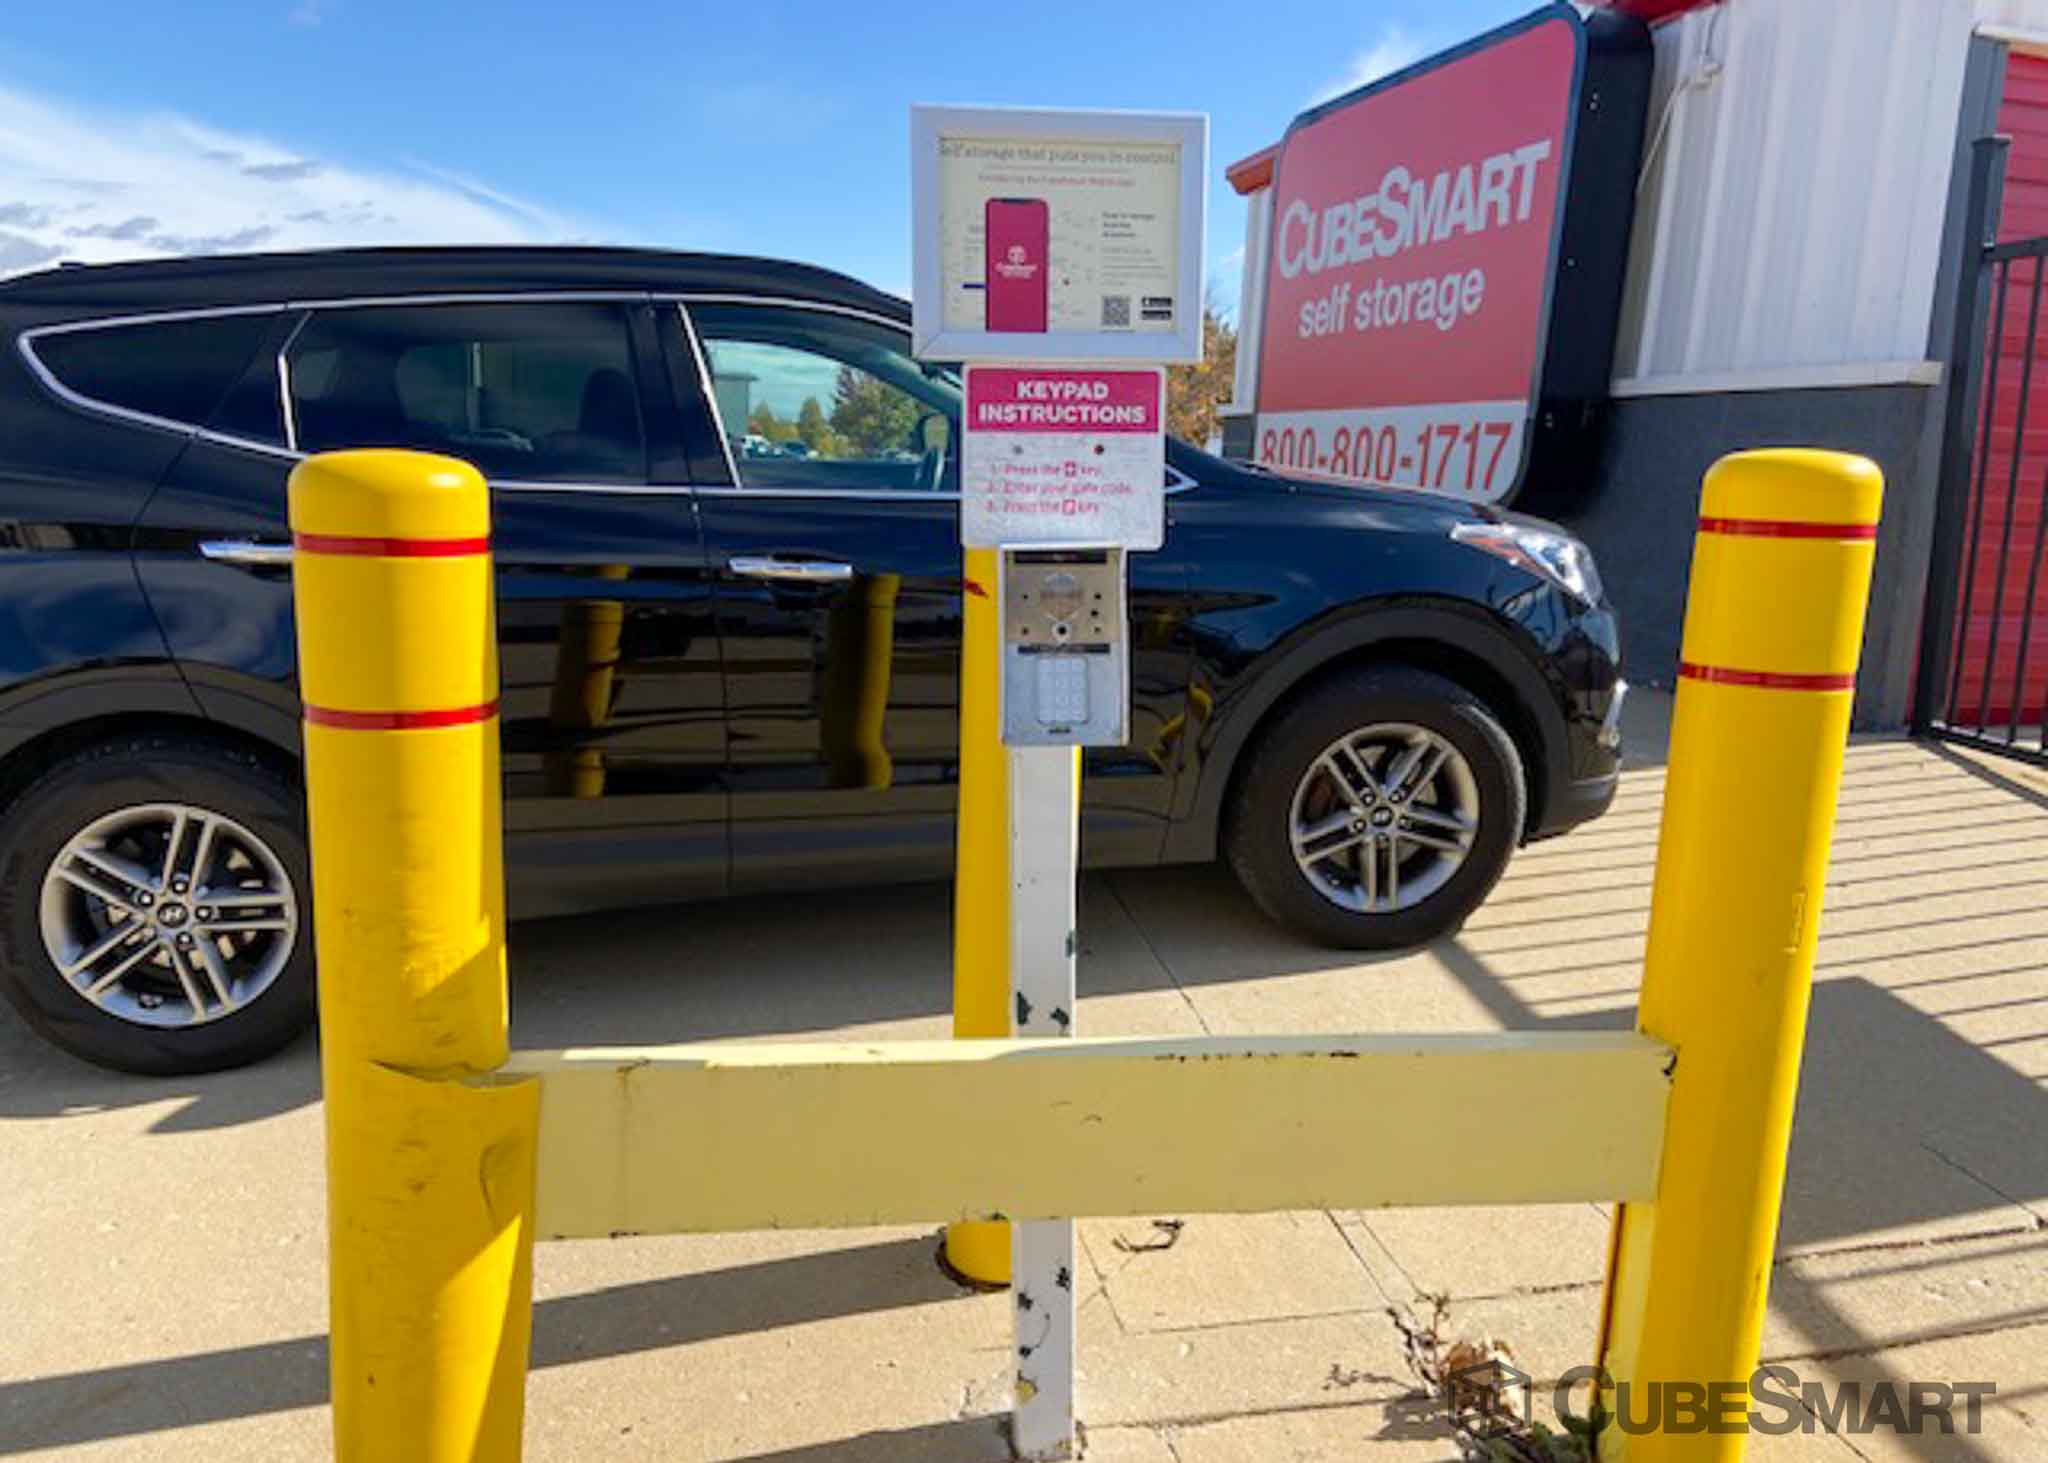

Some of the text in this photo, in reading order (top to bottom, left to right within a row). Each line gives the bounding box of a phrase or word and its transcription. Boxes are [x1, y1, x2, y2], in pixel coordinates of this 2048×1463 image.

[1017, 147, 1046, 160] that
[1299, 267, 1486, 338] self storage
[1016, 380, 1110, 400] KEYPAD
[978, 402, 1147, 424] INSTRUCTIONS
